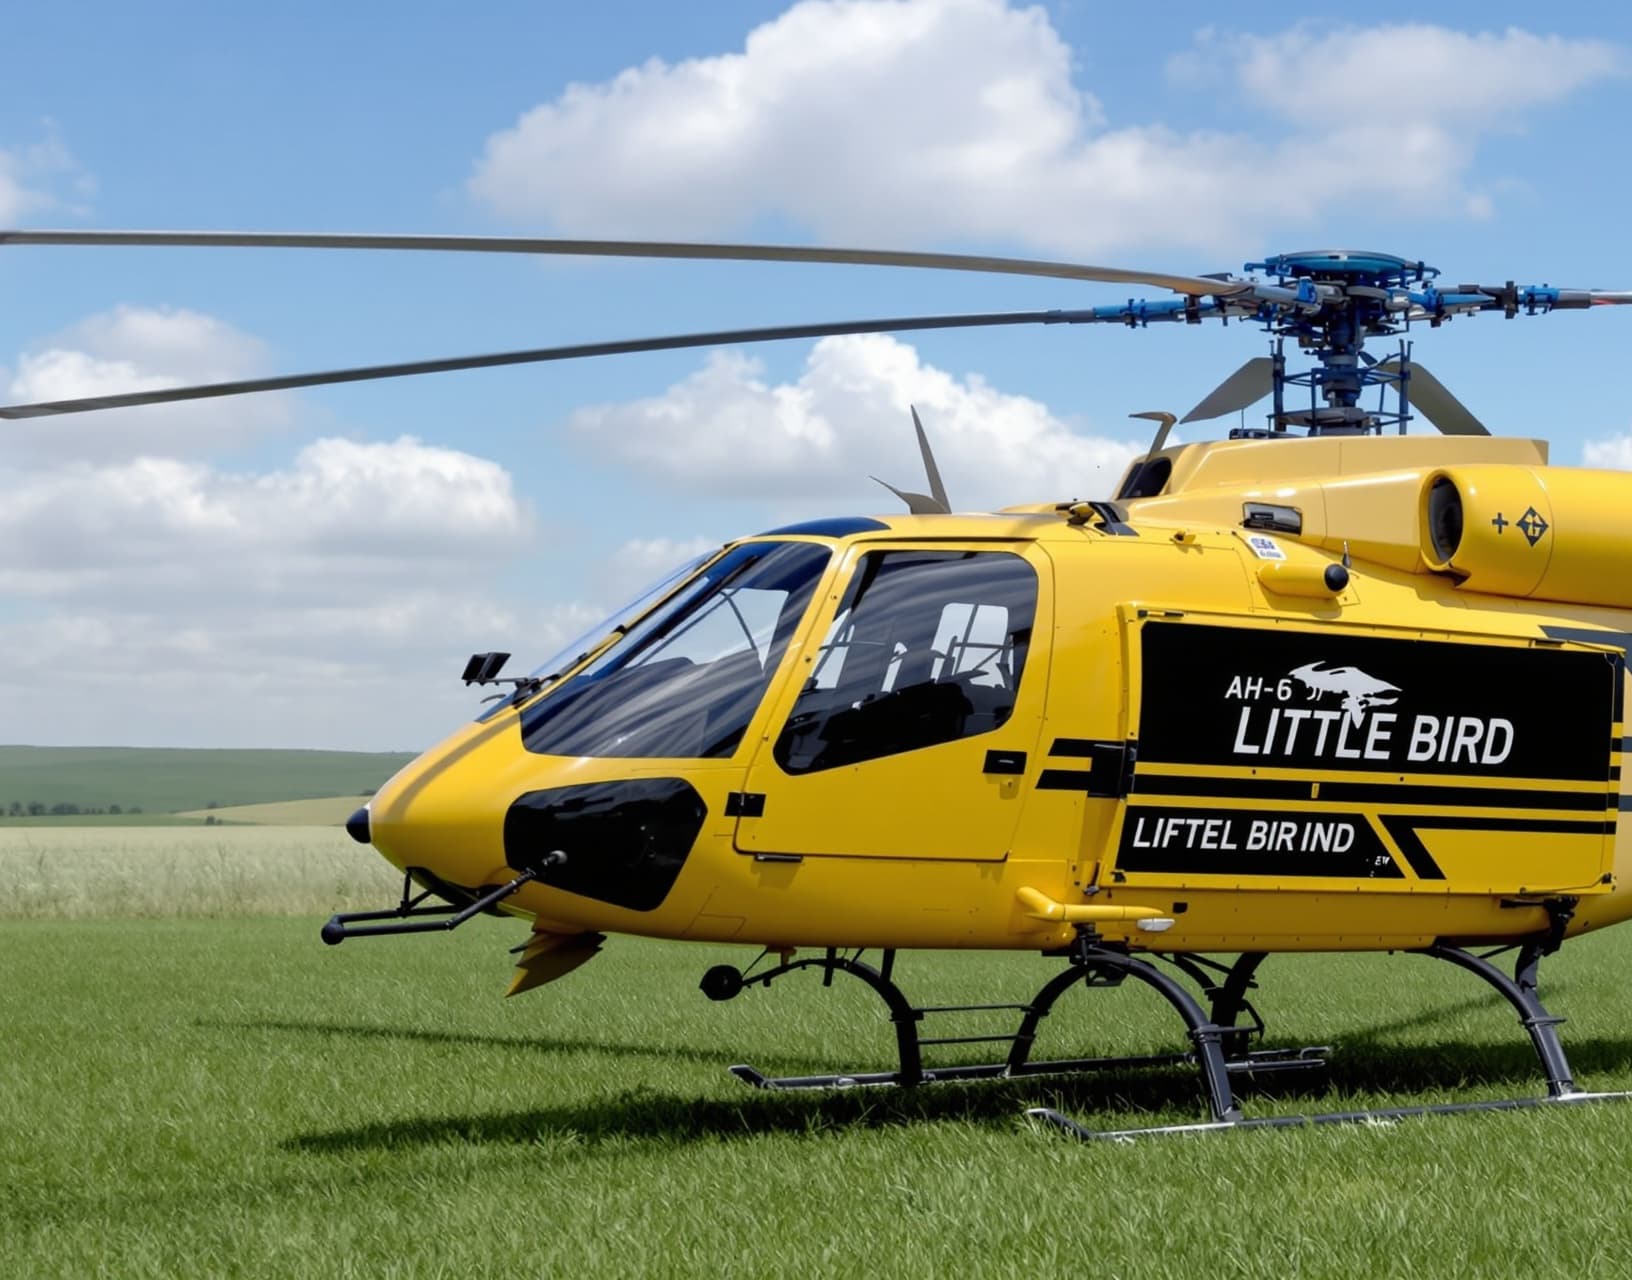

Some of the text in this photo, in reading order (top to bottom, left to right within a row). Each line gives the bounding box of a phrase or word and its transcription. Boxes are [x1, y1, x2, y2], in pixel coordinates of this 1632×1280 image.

[1224, 675, 1293, 701] AH-6
[1233, 706, 1515, 765] LITTLE BIRD
[1133, 817, 1237, 850] LIFTEL
